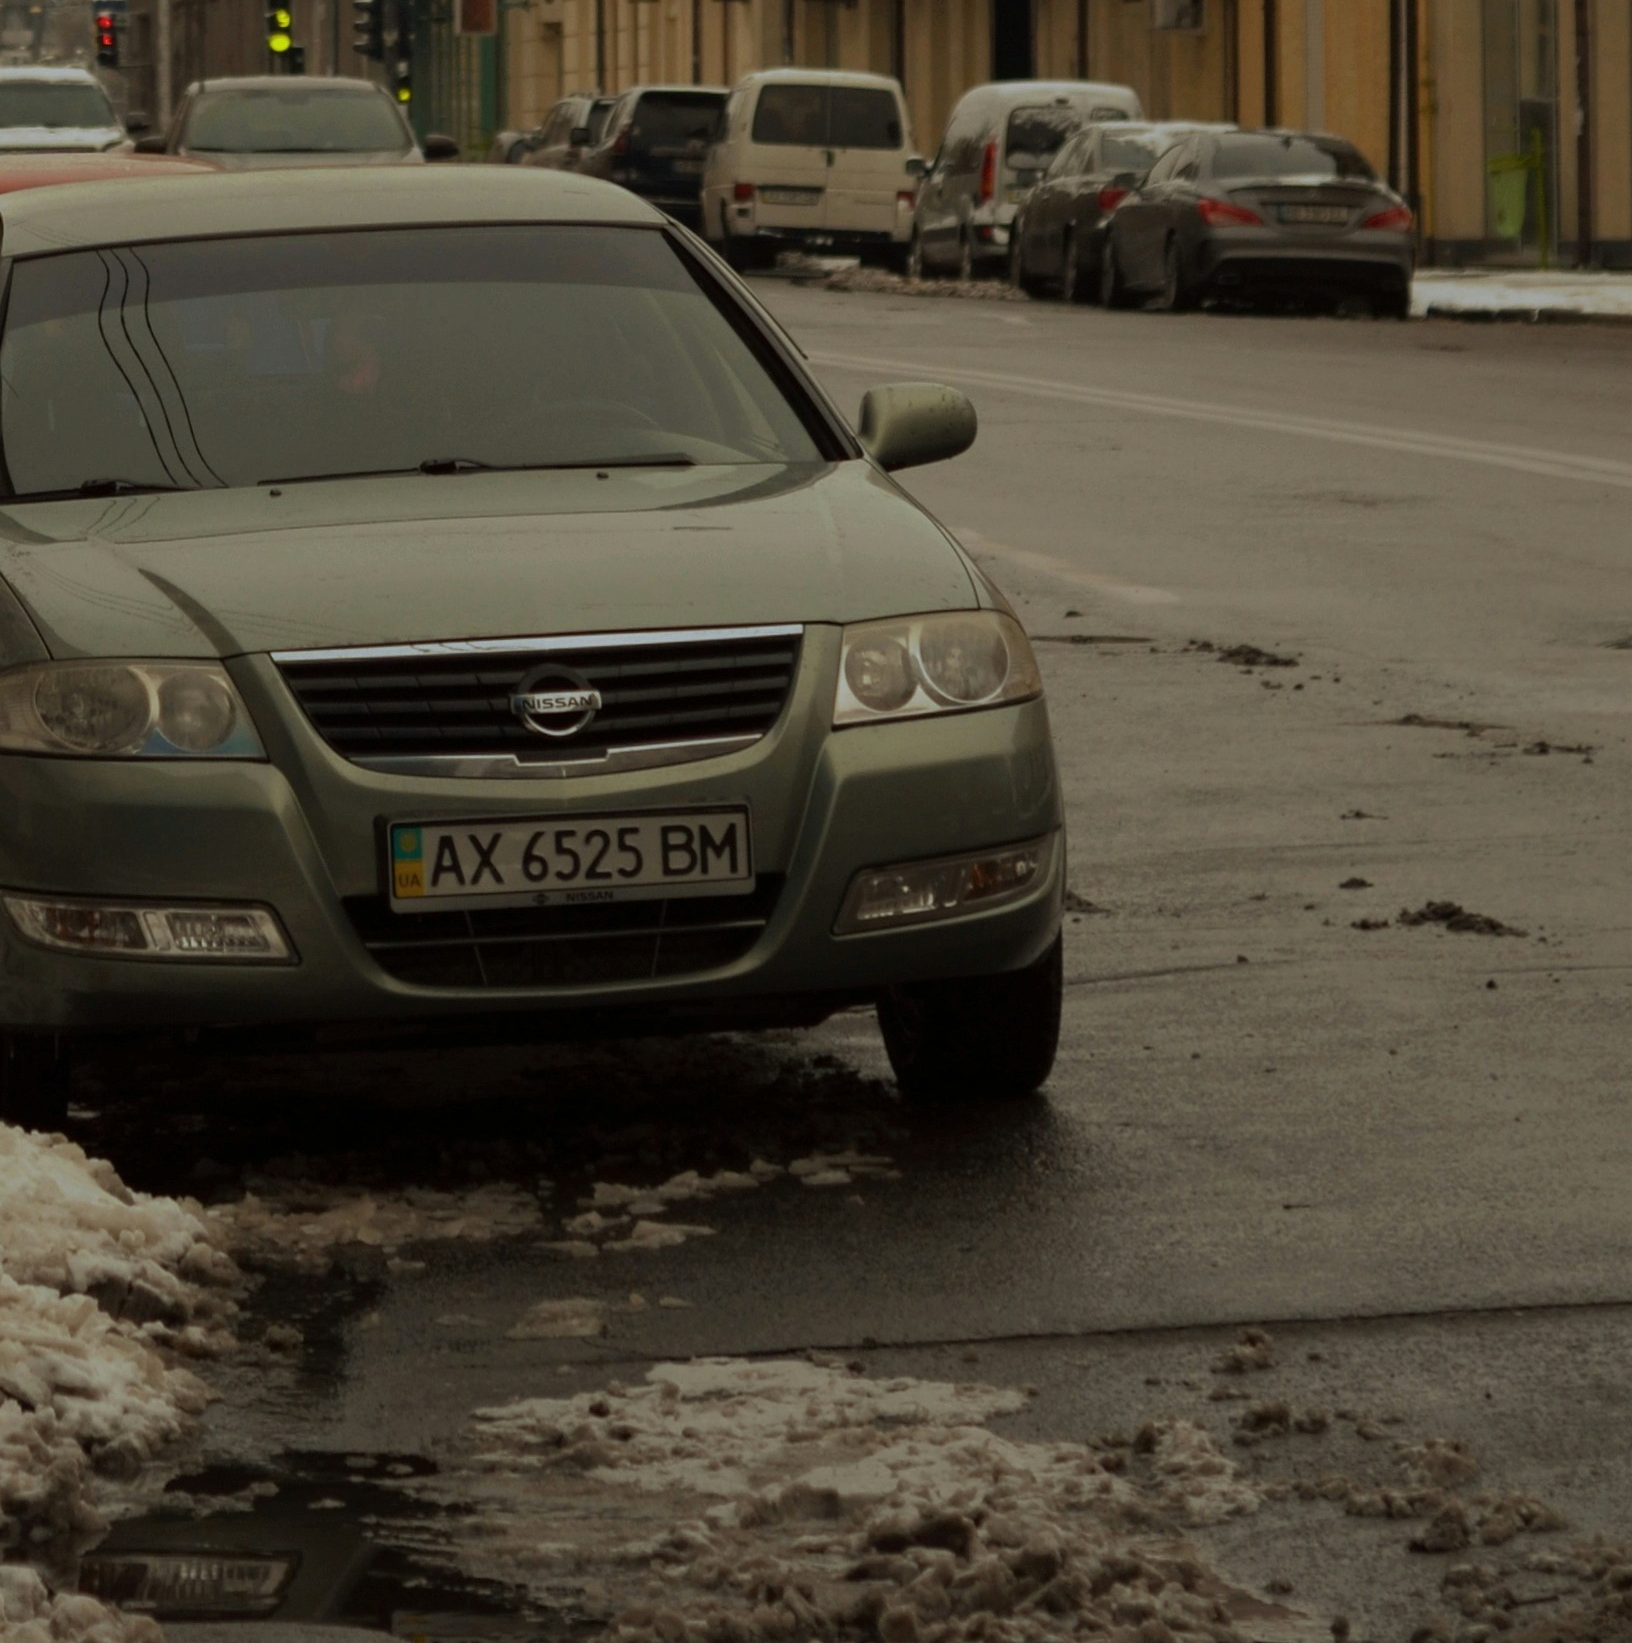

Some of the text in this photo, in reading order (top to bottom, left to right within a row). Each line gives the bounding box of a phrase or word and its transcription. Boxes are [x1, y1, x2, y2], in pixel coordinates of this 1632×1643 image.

[521, 694, 594, 710] NISSAN
[430, 822, 739, 888] AX 6525 BM
[398, 873, 422, 889] UA
[566, 890, 614, 902] NISSAN
